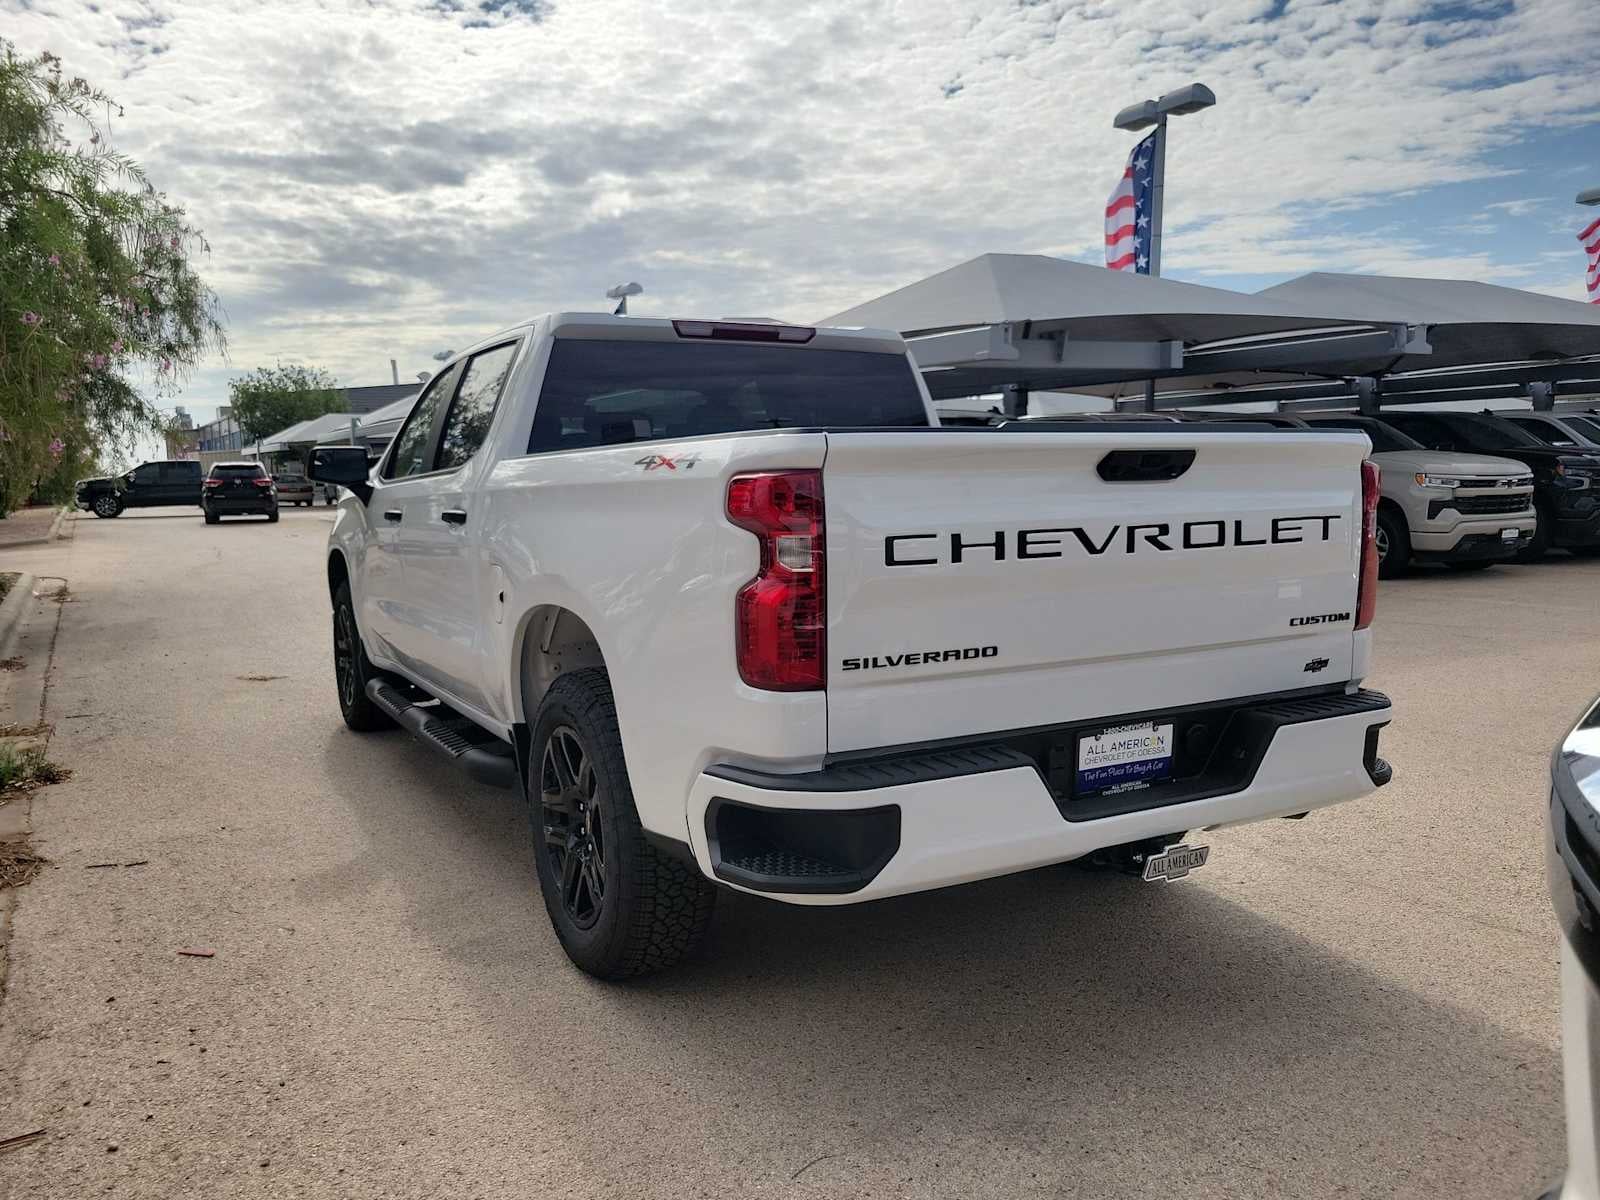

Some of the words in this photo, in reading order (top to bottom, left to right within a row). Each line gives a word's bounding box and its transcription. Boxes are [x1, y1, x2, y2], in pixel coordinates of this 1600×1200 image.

[884, 515, 1341, 566] CHEVROLET
[1289, 612, 1350, 627] CUSTOM
[842, 645, 998, 671] SILVERADO
[1084, 752, 1125, 765] CHEVROLET
[1127, 750, 1137, 759] OF
[1138, 747, 1166, 757] ODESSA
[1087, 743, 1106, 756] ALL
[1152, 859, 1167, 875] ALL
[1167, 850, 1204, 871] AMERICAN
